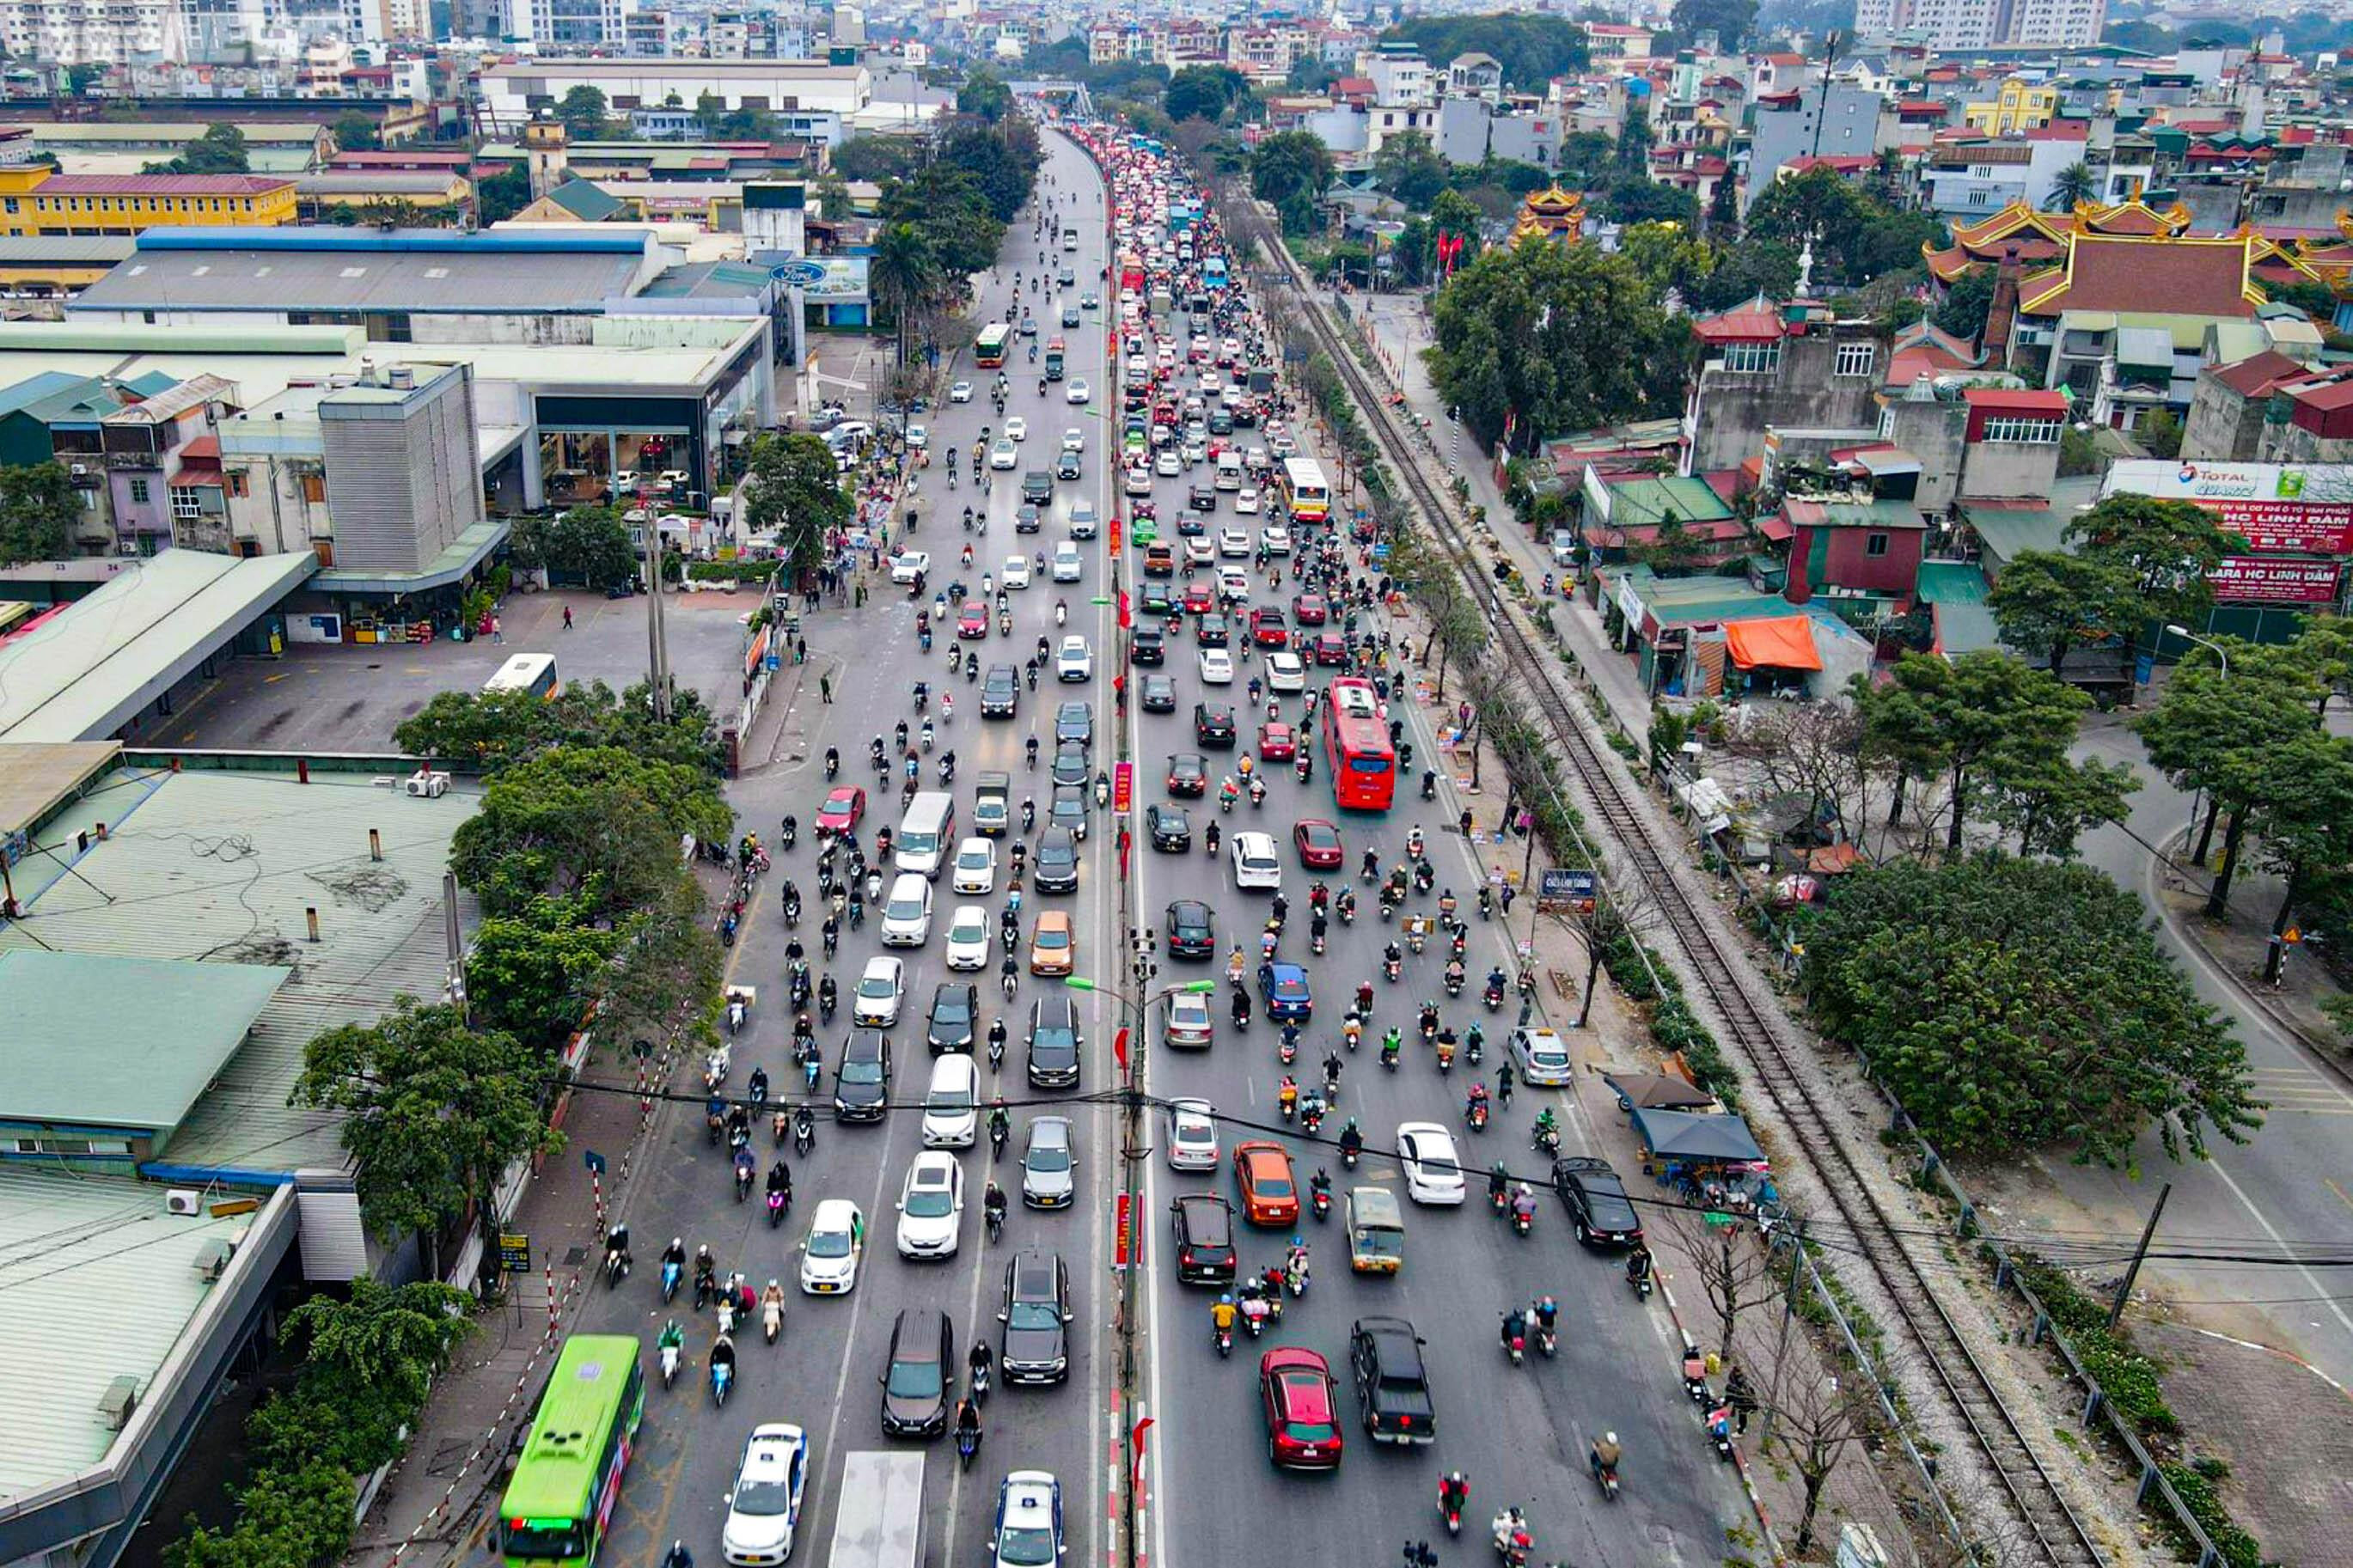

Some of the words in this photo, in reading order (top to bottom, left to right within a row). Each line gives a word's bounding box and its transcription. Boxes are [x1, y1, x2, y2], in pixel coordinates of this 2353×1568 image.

[781, 265, 813, 281] Ford
[2200, 471, 2250, 482] TOTAL
[2223, 514, 2252, 522] HC
[2258, 515, 2301, 523] LINH
[2245, 569, 2266, 579] HC
[2268, 570, 2301, 580] LINH
